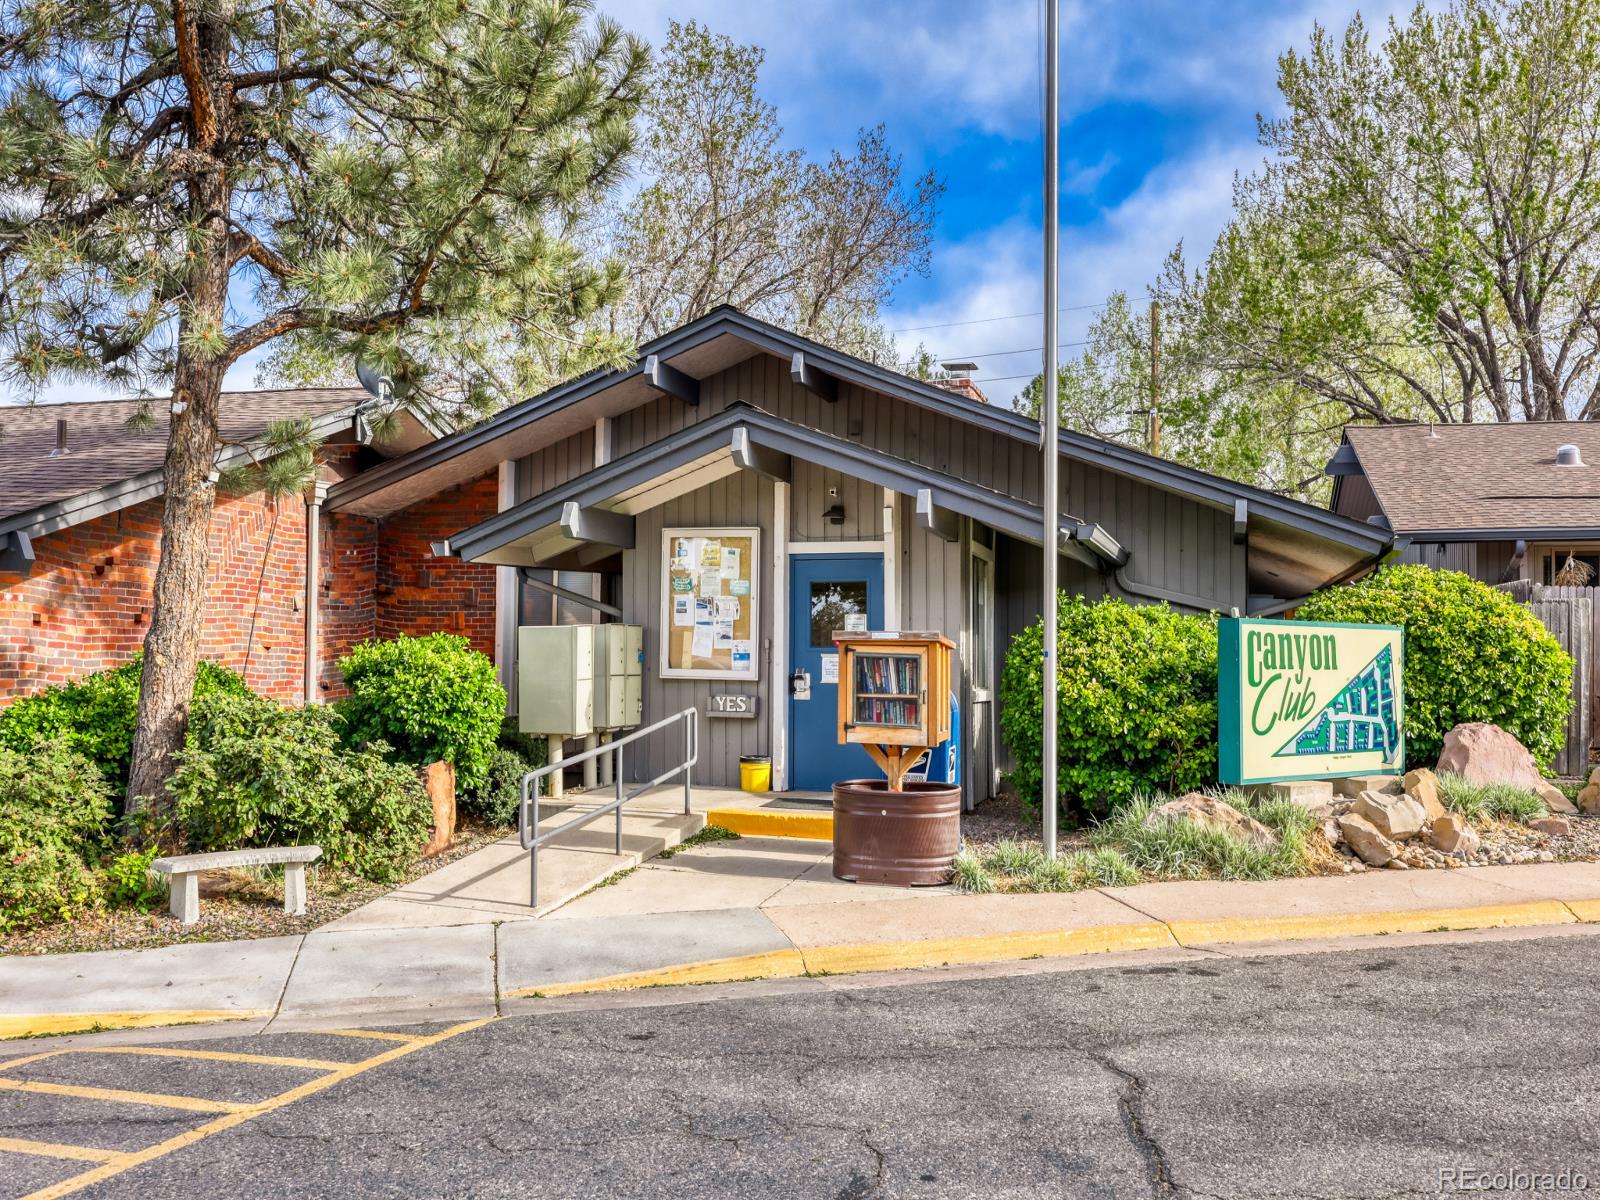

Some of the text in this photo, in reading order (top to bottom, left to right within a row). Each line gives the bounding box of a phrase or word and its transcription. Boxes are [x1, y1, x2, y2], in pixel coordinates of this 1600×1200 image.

[1247, 630, 1338, 687] Canyon
[715, 696, 747, 712] YES
[1252, 673, 1316, 736] Club
